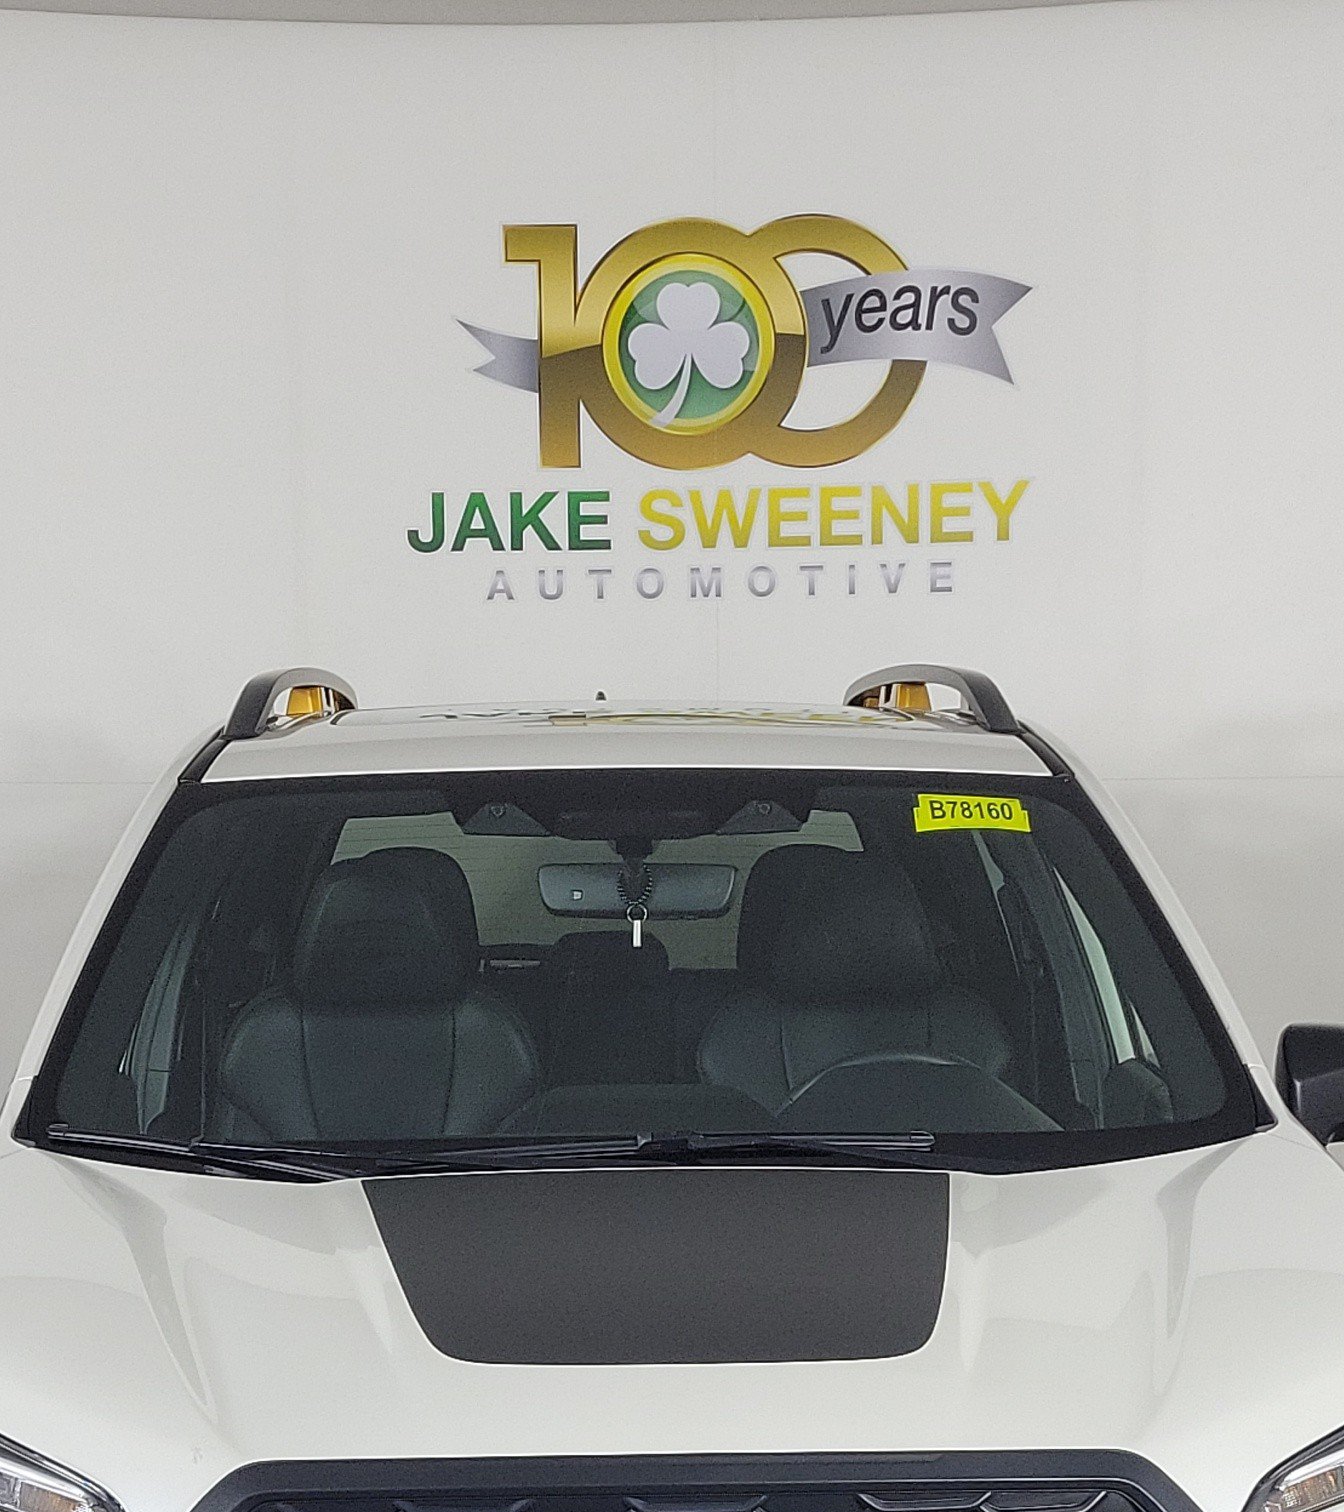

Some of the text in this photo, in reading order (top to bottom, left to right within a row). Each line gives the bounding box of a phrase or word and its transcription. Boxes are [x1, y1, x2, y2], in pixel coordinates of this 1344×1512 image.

[503, 214, 981, 471] 100 years
[406, 479, 1032, 554] JAKE SWEENEY
[486, 560, 954, 601] AUTOMOTIVE
[929, 799, 1014, 821] B78160
